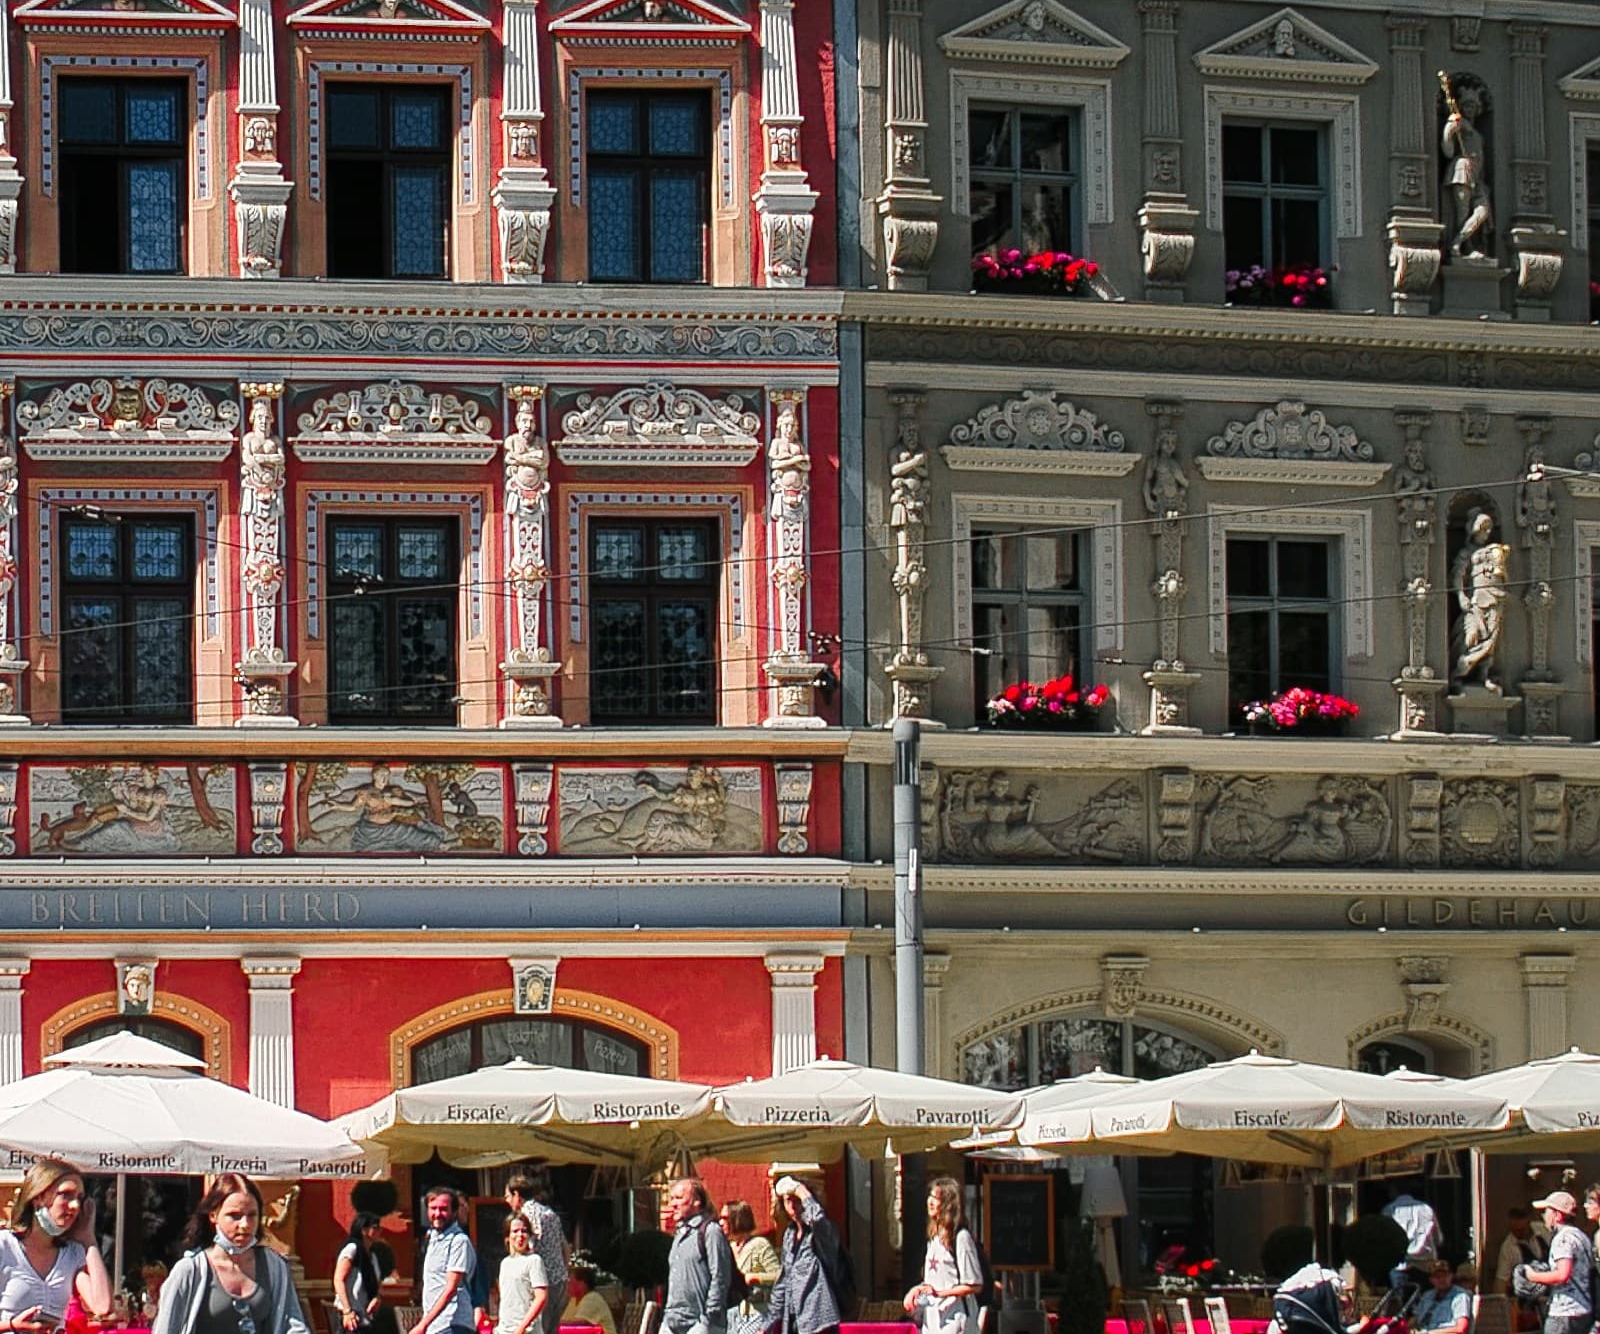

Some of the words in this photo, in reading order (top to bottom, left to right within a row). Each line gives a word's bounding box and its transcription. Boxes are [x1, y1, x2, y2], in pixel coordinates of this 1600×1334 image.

[30, 892, 211, 923] BREITEN
[242, 892, 361, 922] HERD
[1348, 899, 1590, 925] GILDEHAU
[593, 1101, 681, 1118] Ristorante
[765, 1106, 831, 1124] Pizzeria
[916, 1107, 990, 1125] Pavarotti
[1385, 1110, 1466, 1127] Ristorante
[99, 1152, 176, 1168] Ristorante
[211, 1155, 268, 1172] Pizzeria
[300, 1158, 367, 1175] Pavarotti
